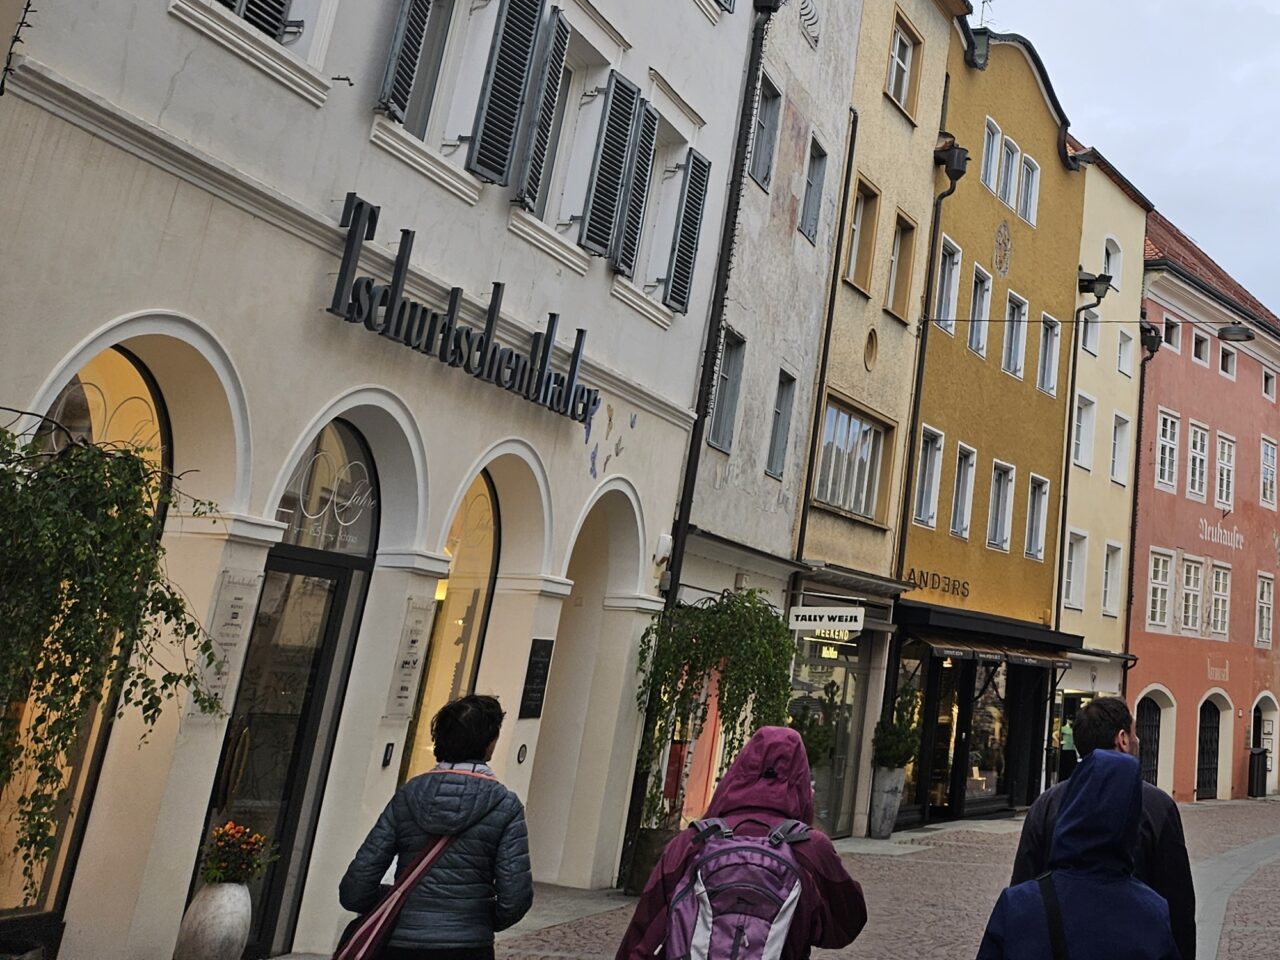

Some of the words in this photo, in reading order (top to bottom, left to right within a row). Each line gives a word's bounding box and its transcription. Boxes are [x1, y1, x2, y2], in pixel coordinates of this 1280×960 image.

[326, 191, 600, 424] Tschurtschenthaler
[794, 614, 825, 623] TALLY
[815, 628, 850, 641] WEEKEND
